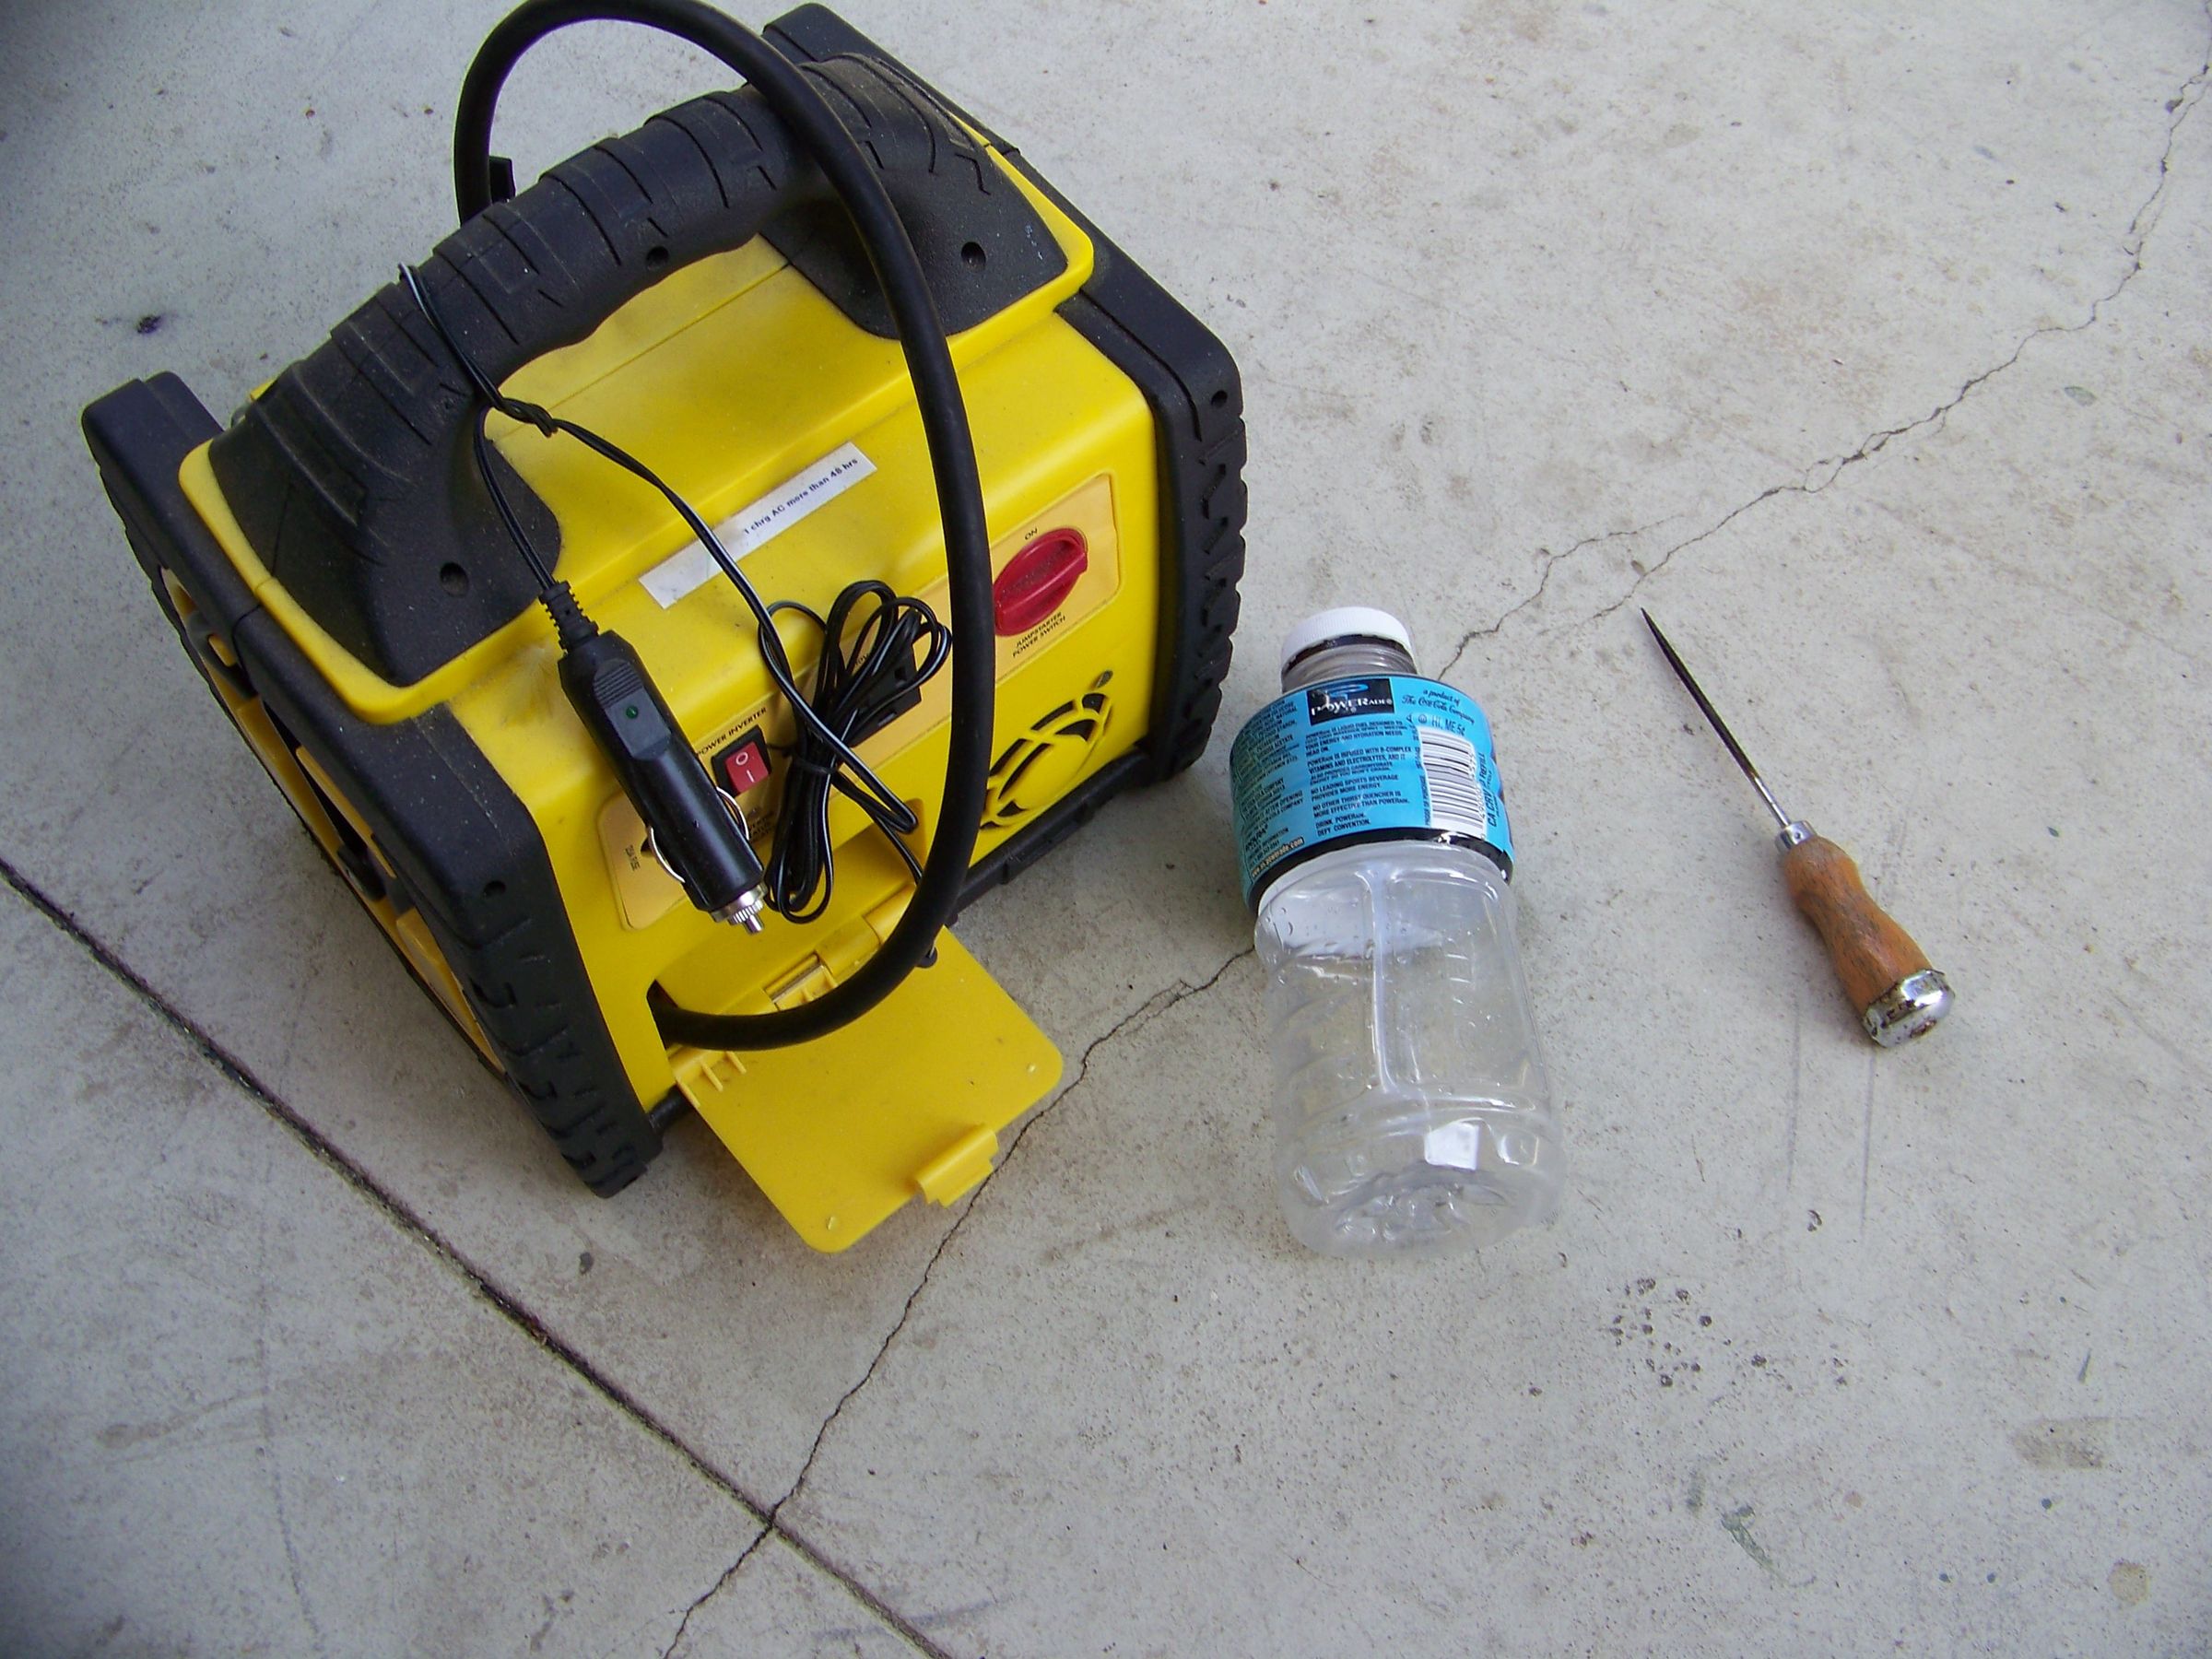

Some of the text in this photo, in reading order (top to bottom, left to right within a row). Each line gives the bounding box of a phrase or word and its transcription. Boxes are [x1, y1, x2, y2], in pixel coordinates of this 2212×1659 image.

[771, 505, 785, 516] AC
[786, 491, 808, 507] more
[808, 477, 830, 491] than
[841, 459, 858, 469] hrs
[1025, 527, 1038, 540] ON
[1013, 616, 1066, 657] POWER SWITCH
[1401, 694, 1416, 705] The
[728, 707, 767, 735] INVERTER
[1319, 737, 1339, 746] ENERGY
[1309, 762, 1333, 774] VITAMINS
[1319, 782, 1344, 793] LEADING
[1312, 792, 1339, 802] PROVIDES
[1322, 799, 1340, 808] OTHER
[1341, 794, 1361, 804] THIRST
[1362, 791, 1394, 799] QUENCHER
[1484, 789, 1497, 811] CRV
[1313, 810, 1330, 818] MORE
[1330, 803, 1359, 814] EFFECTIVE
[1315, 819, 1333, 829] DRINK
[1487, 812, 1497, 827] CA
[1317, 829, 1331, 837] DEFY
